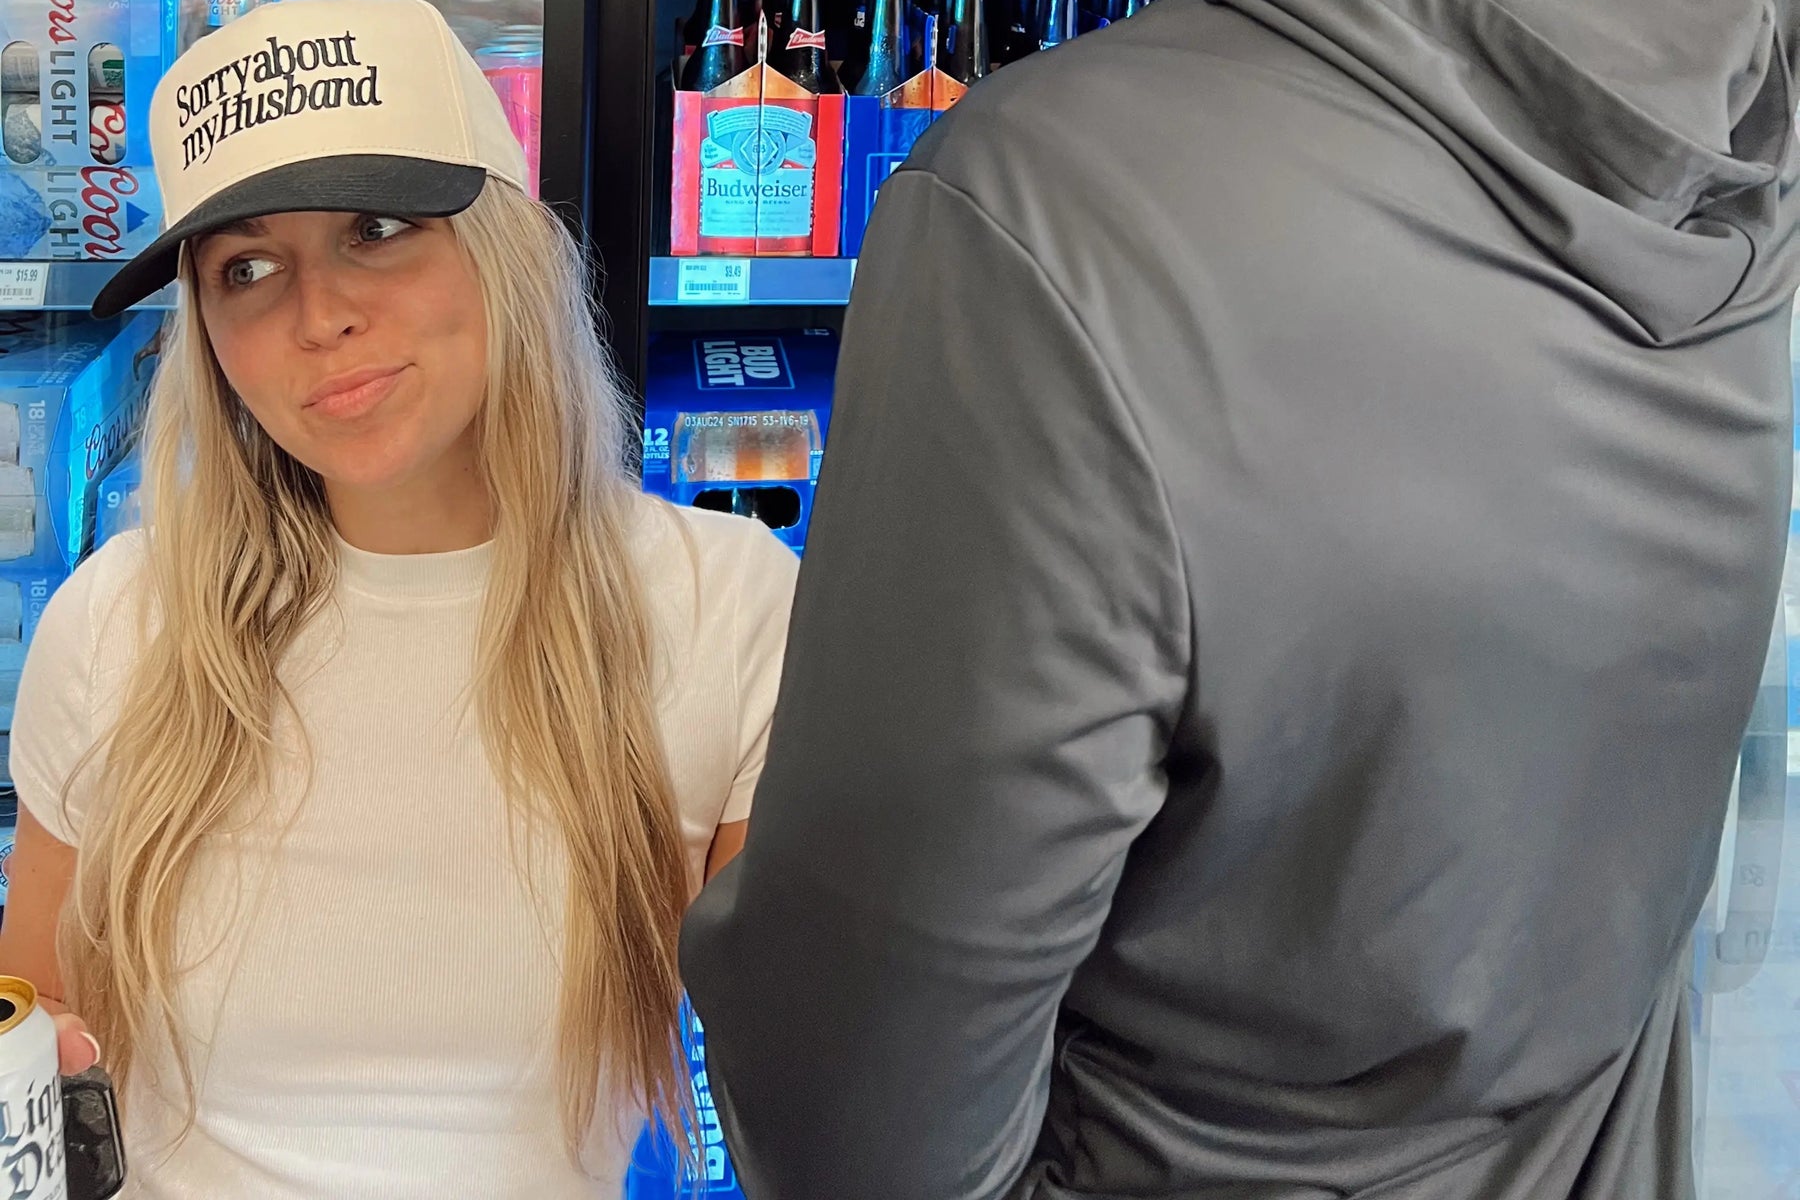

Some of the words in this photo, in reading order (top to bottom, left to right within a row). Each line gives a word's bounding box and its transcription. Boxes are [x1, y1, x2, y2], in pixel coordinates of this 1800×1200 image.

[50, 51, 79, 147] LIGHT
[706, 177, 808, 198] Budweiser
[80, 164, 139, 260] Coor
[16, 269, 38, 281] $15.99
[703, 340, 745, 386] LIGHT
[739, 345, 781, 379] BUD
[28, 399, 46, 421] 18
[684, 416, 724, 427] 03AUG24
[727, 415, 758, 427] SN1715
[31, 577, 47, 597] 18
